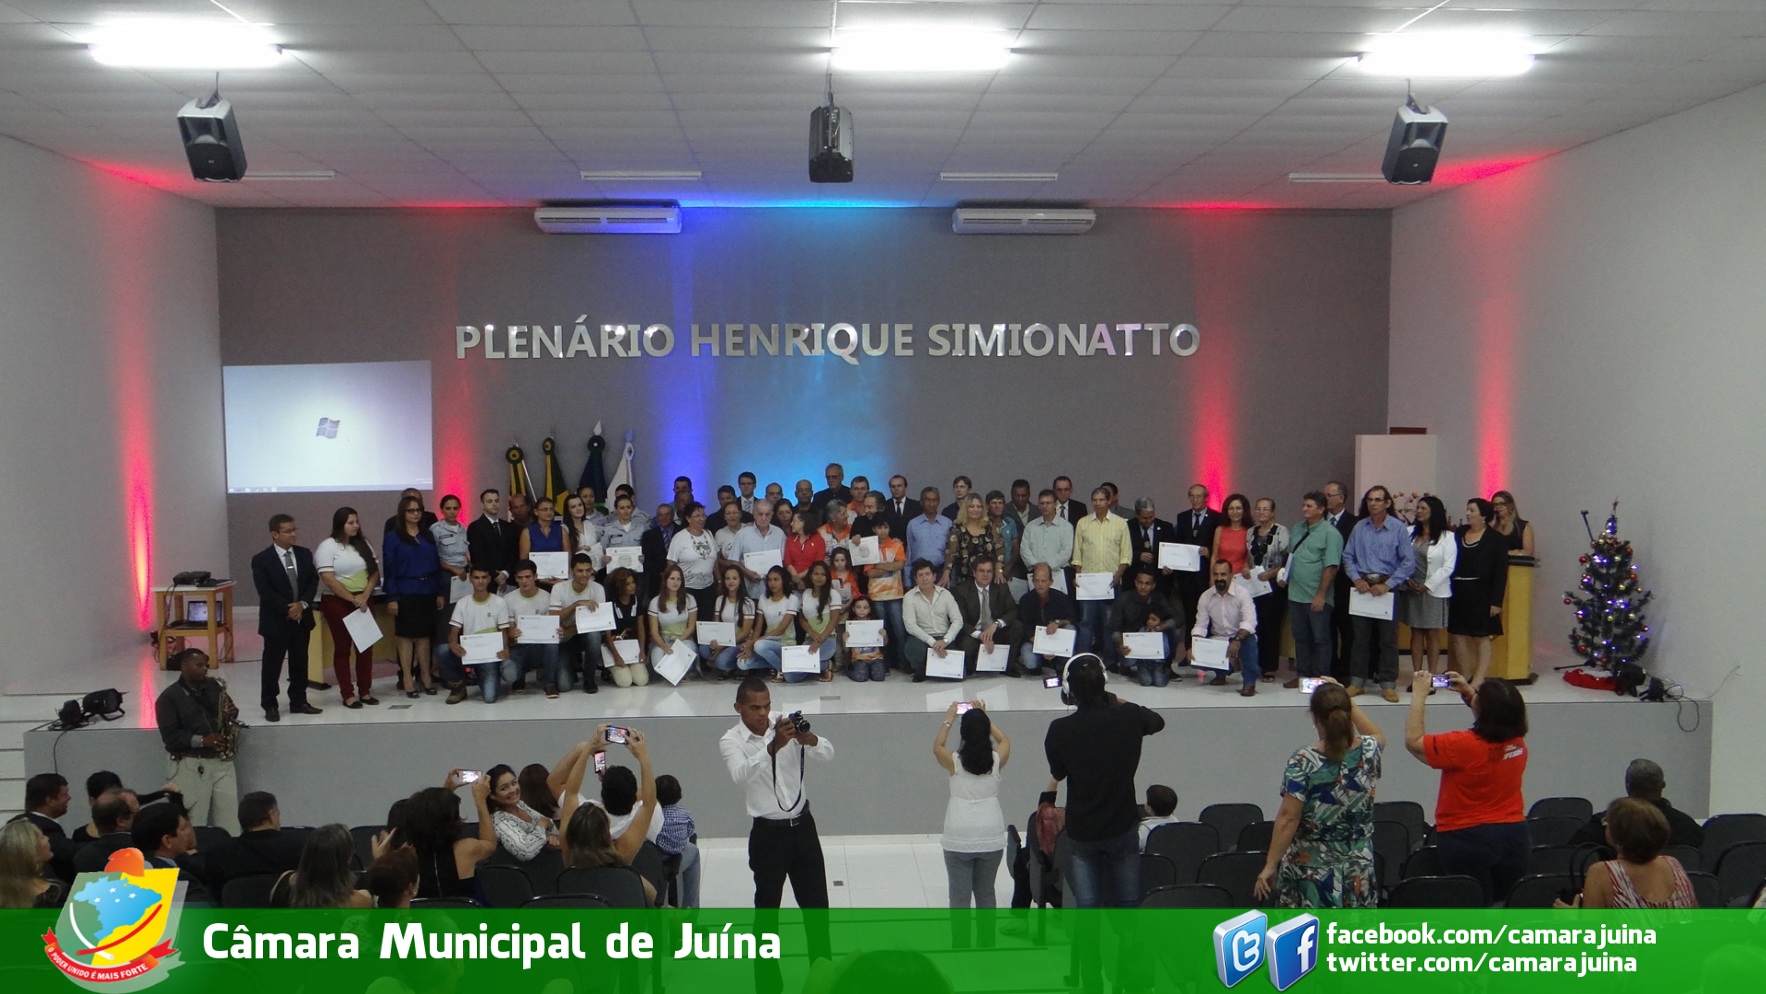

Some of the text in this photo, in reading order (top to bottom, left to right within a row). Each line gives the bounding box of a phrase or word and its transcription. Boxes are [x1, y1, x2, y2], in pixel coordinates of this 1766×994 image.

[455, 314, 1200, 365] PLENÁRIO HENRIQUE SIMIONATTO
